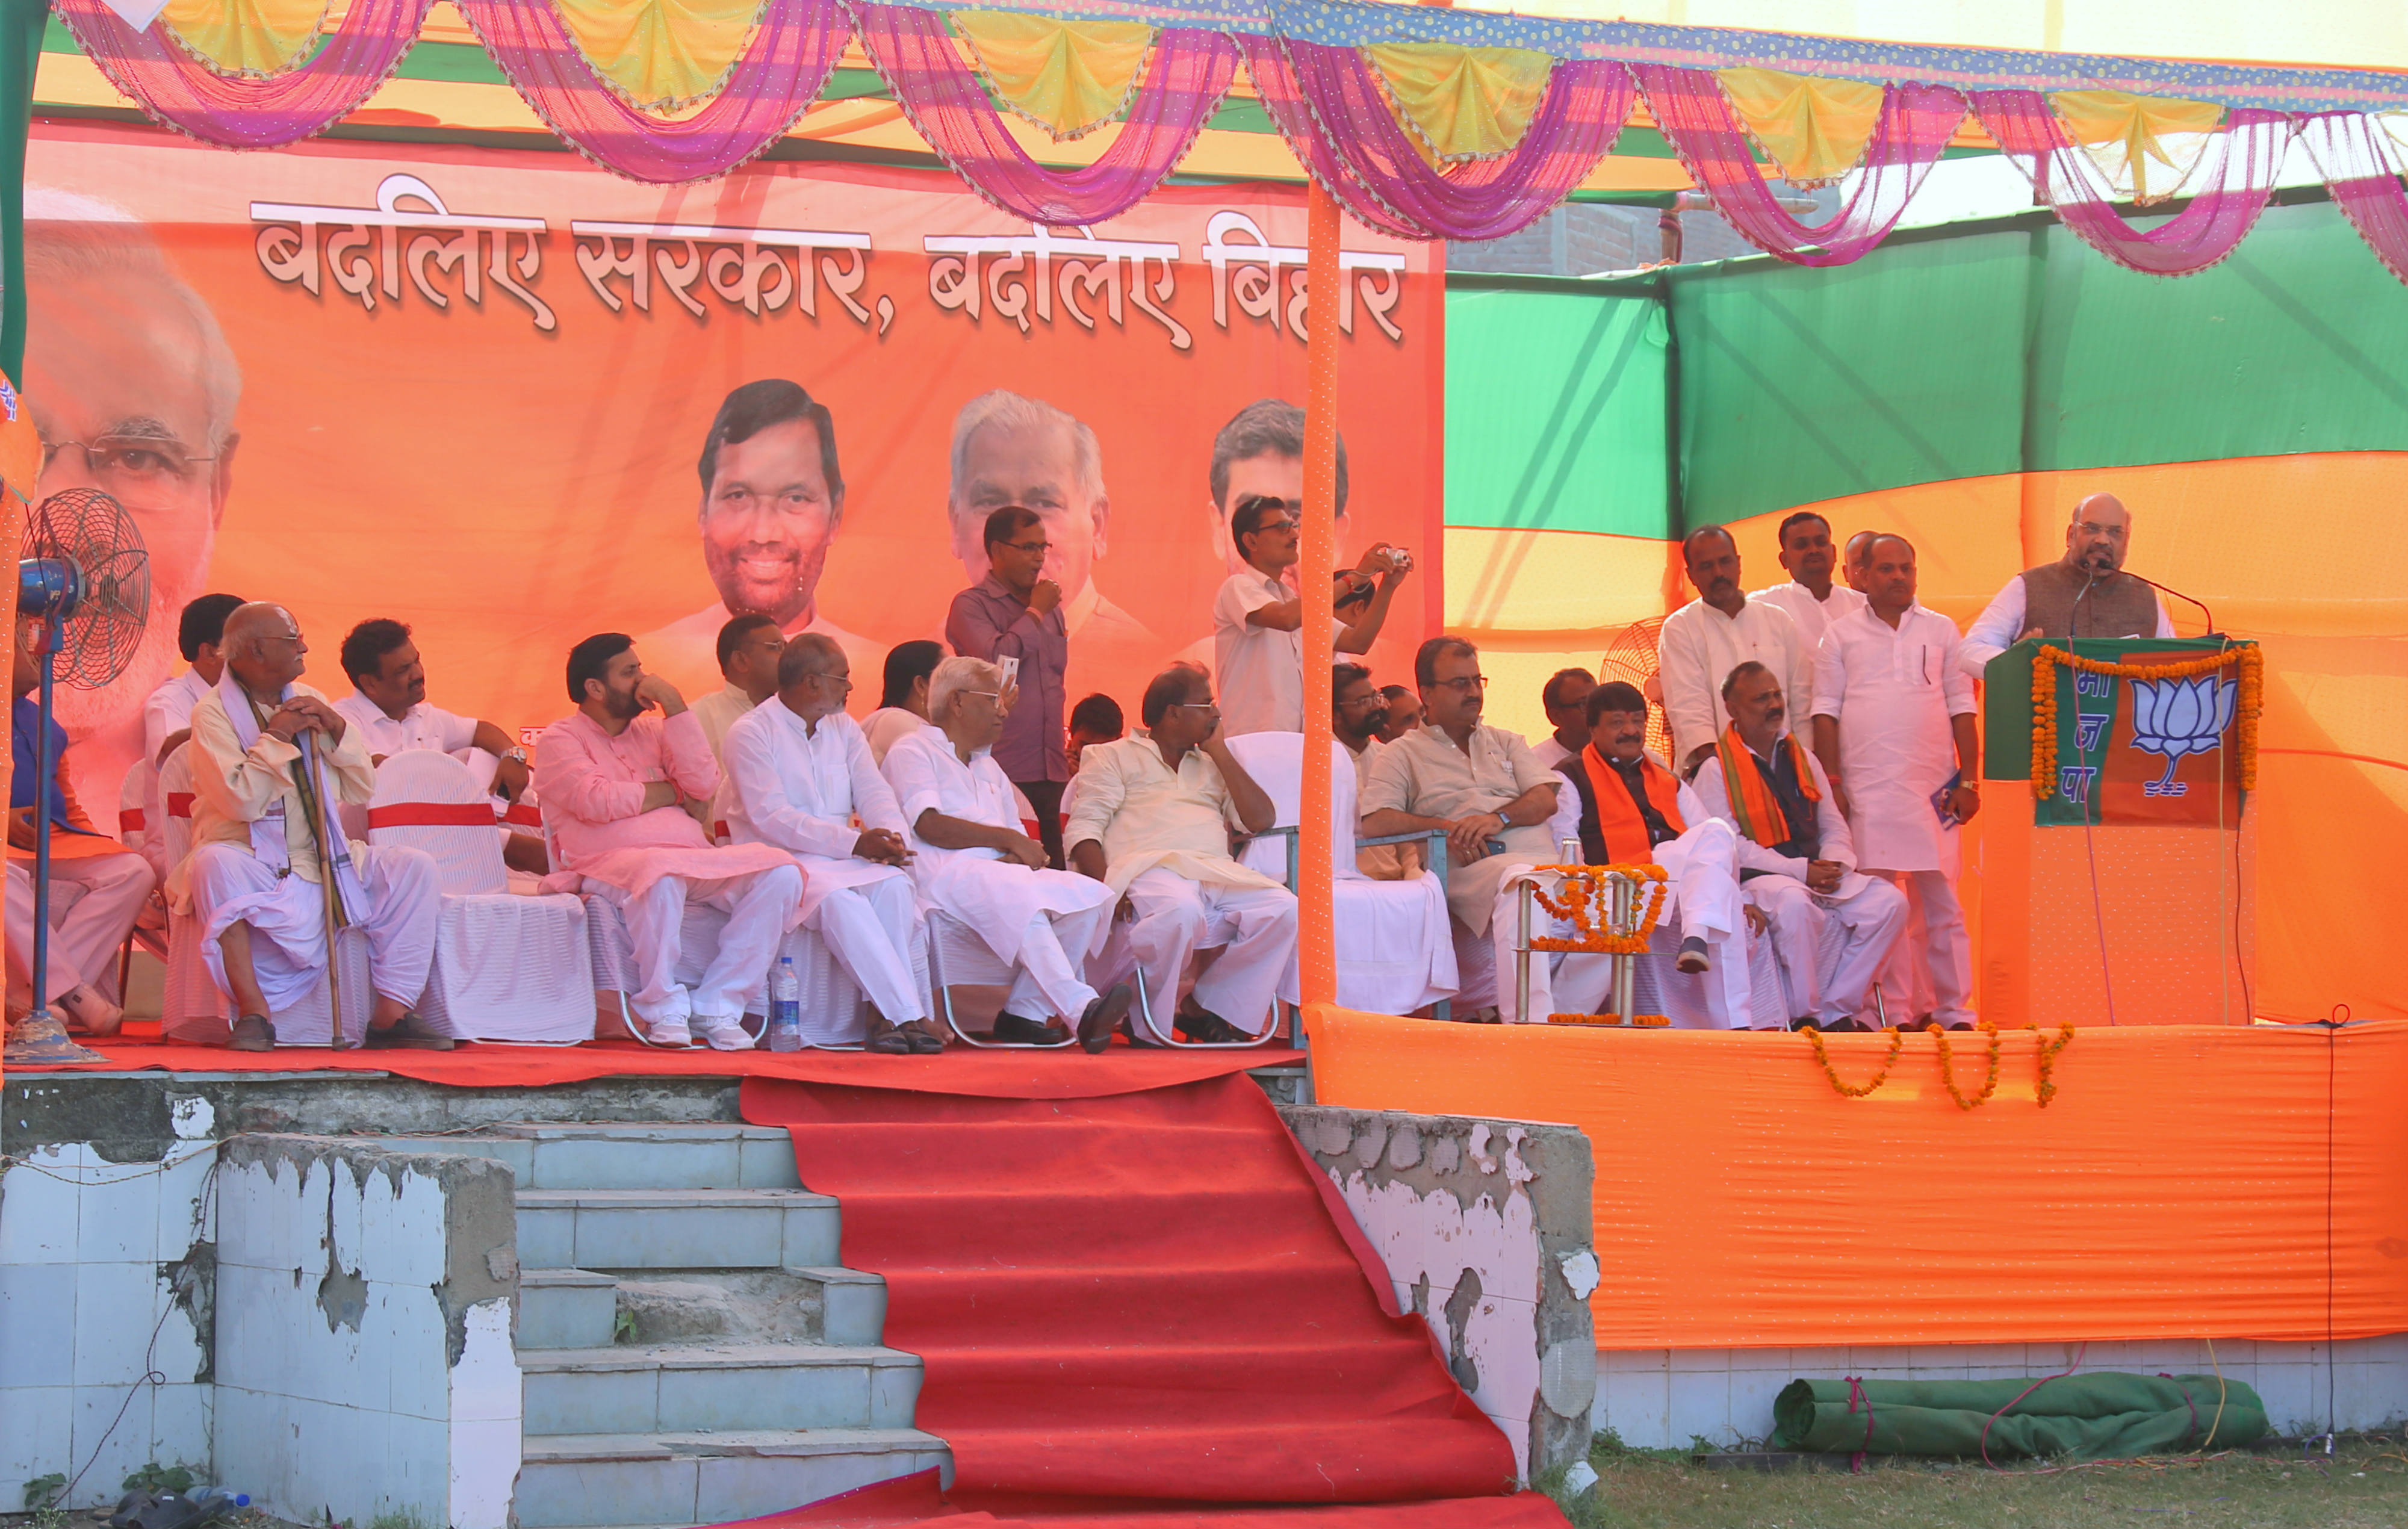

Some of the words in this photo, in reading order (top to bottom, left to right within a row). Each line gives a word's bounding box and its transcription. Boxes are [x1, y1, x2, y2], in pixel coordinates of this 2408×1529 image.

[250, 173, 556, 332] बदलिए
[571, 220, 895, 335] सरकार,
[923, 223, 1193, 350] बदलिए
